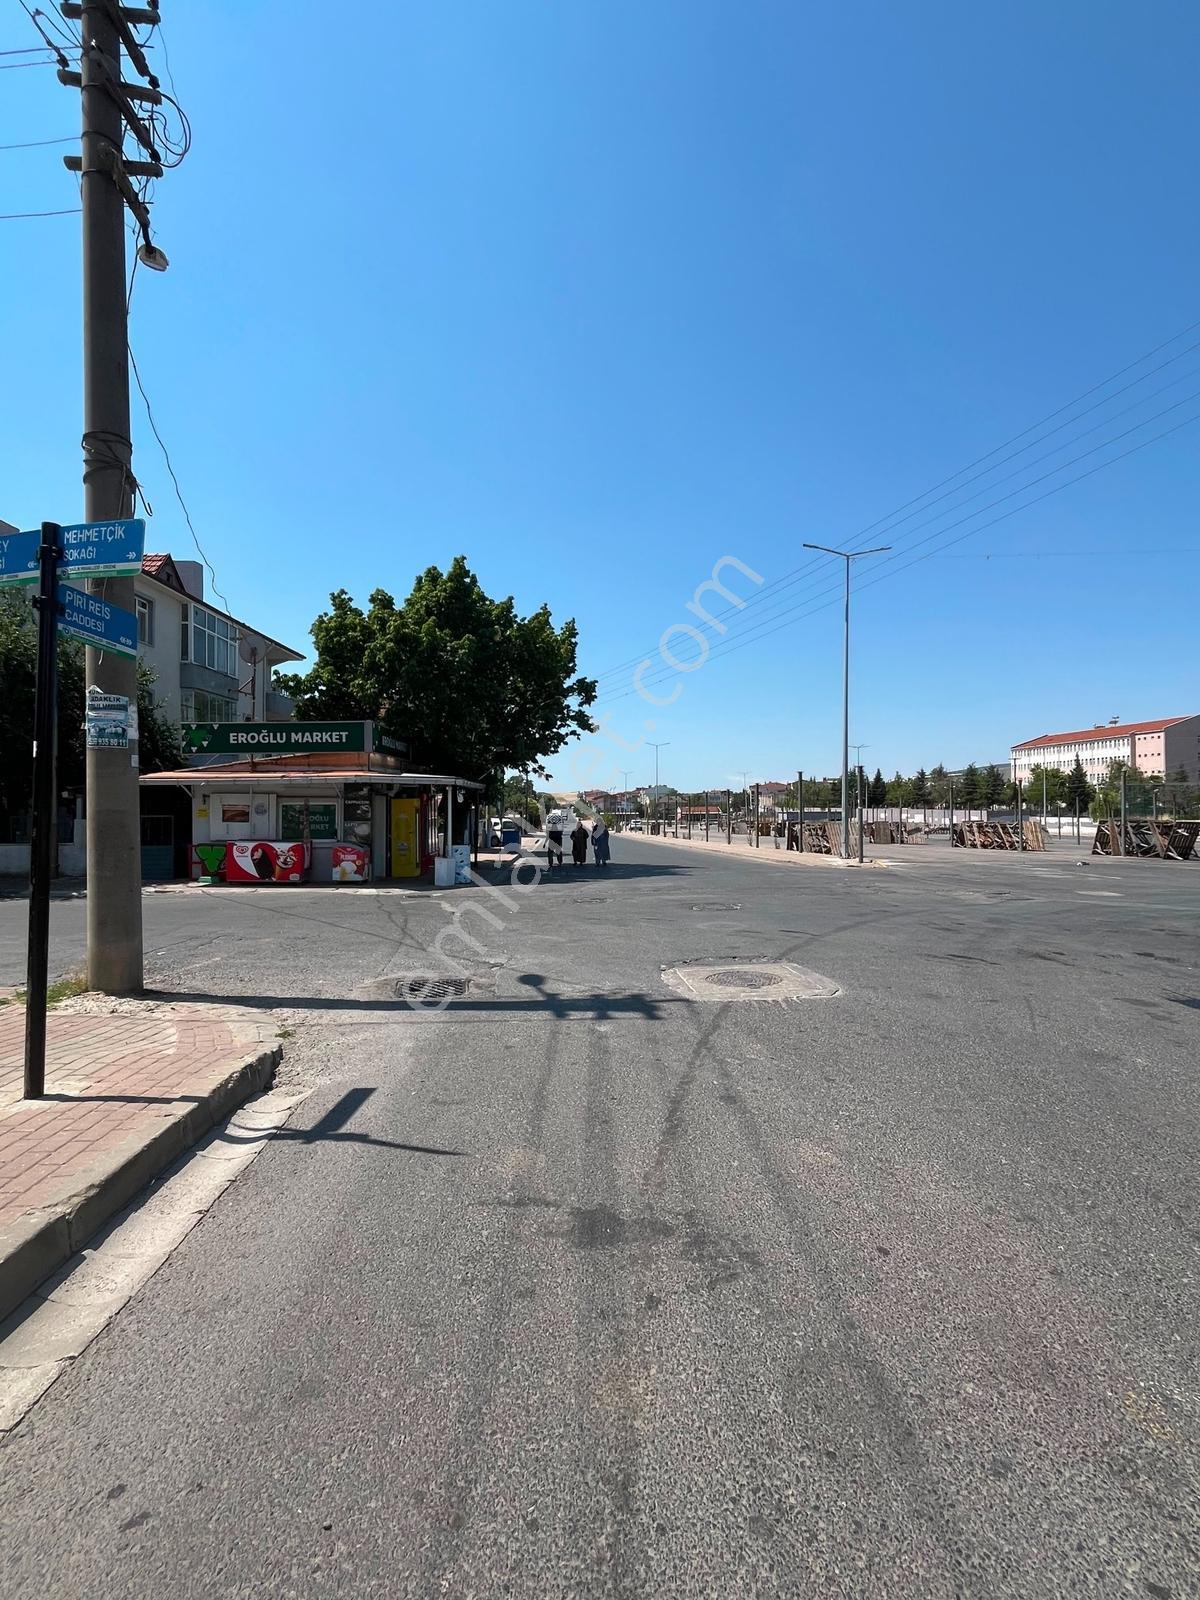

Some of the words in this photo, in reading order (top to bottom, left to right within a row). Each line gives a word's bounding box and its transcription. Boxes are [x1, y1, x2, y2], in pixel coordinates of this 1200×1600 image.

[64, 523, 126, 545] MEHMETÇİK
[63, 546, 96, 562] SOKAĞI
[65, 590, 87, 610] PİRİ
[88, 600, 111, 620] REİS
[65, 609, 105, 633] CADDESİ
[229, 729, 286, 744] EROĞLU
[291, 731, 349, 743] MARKET
